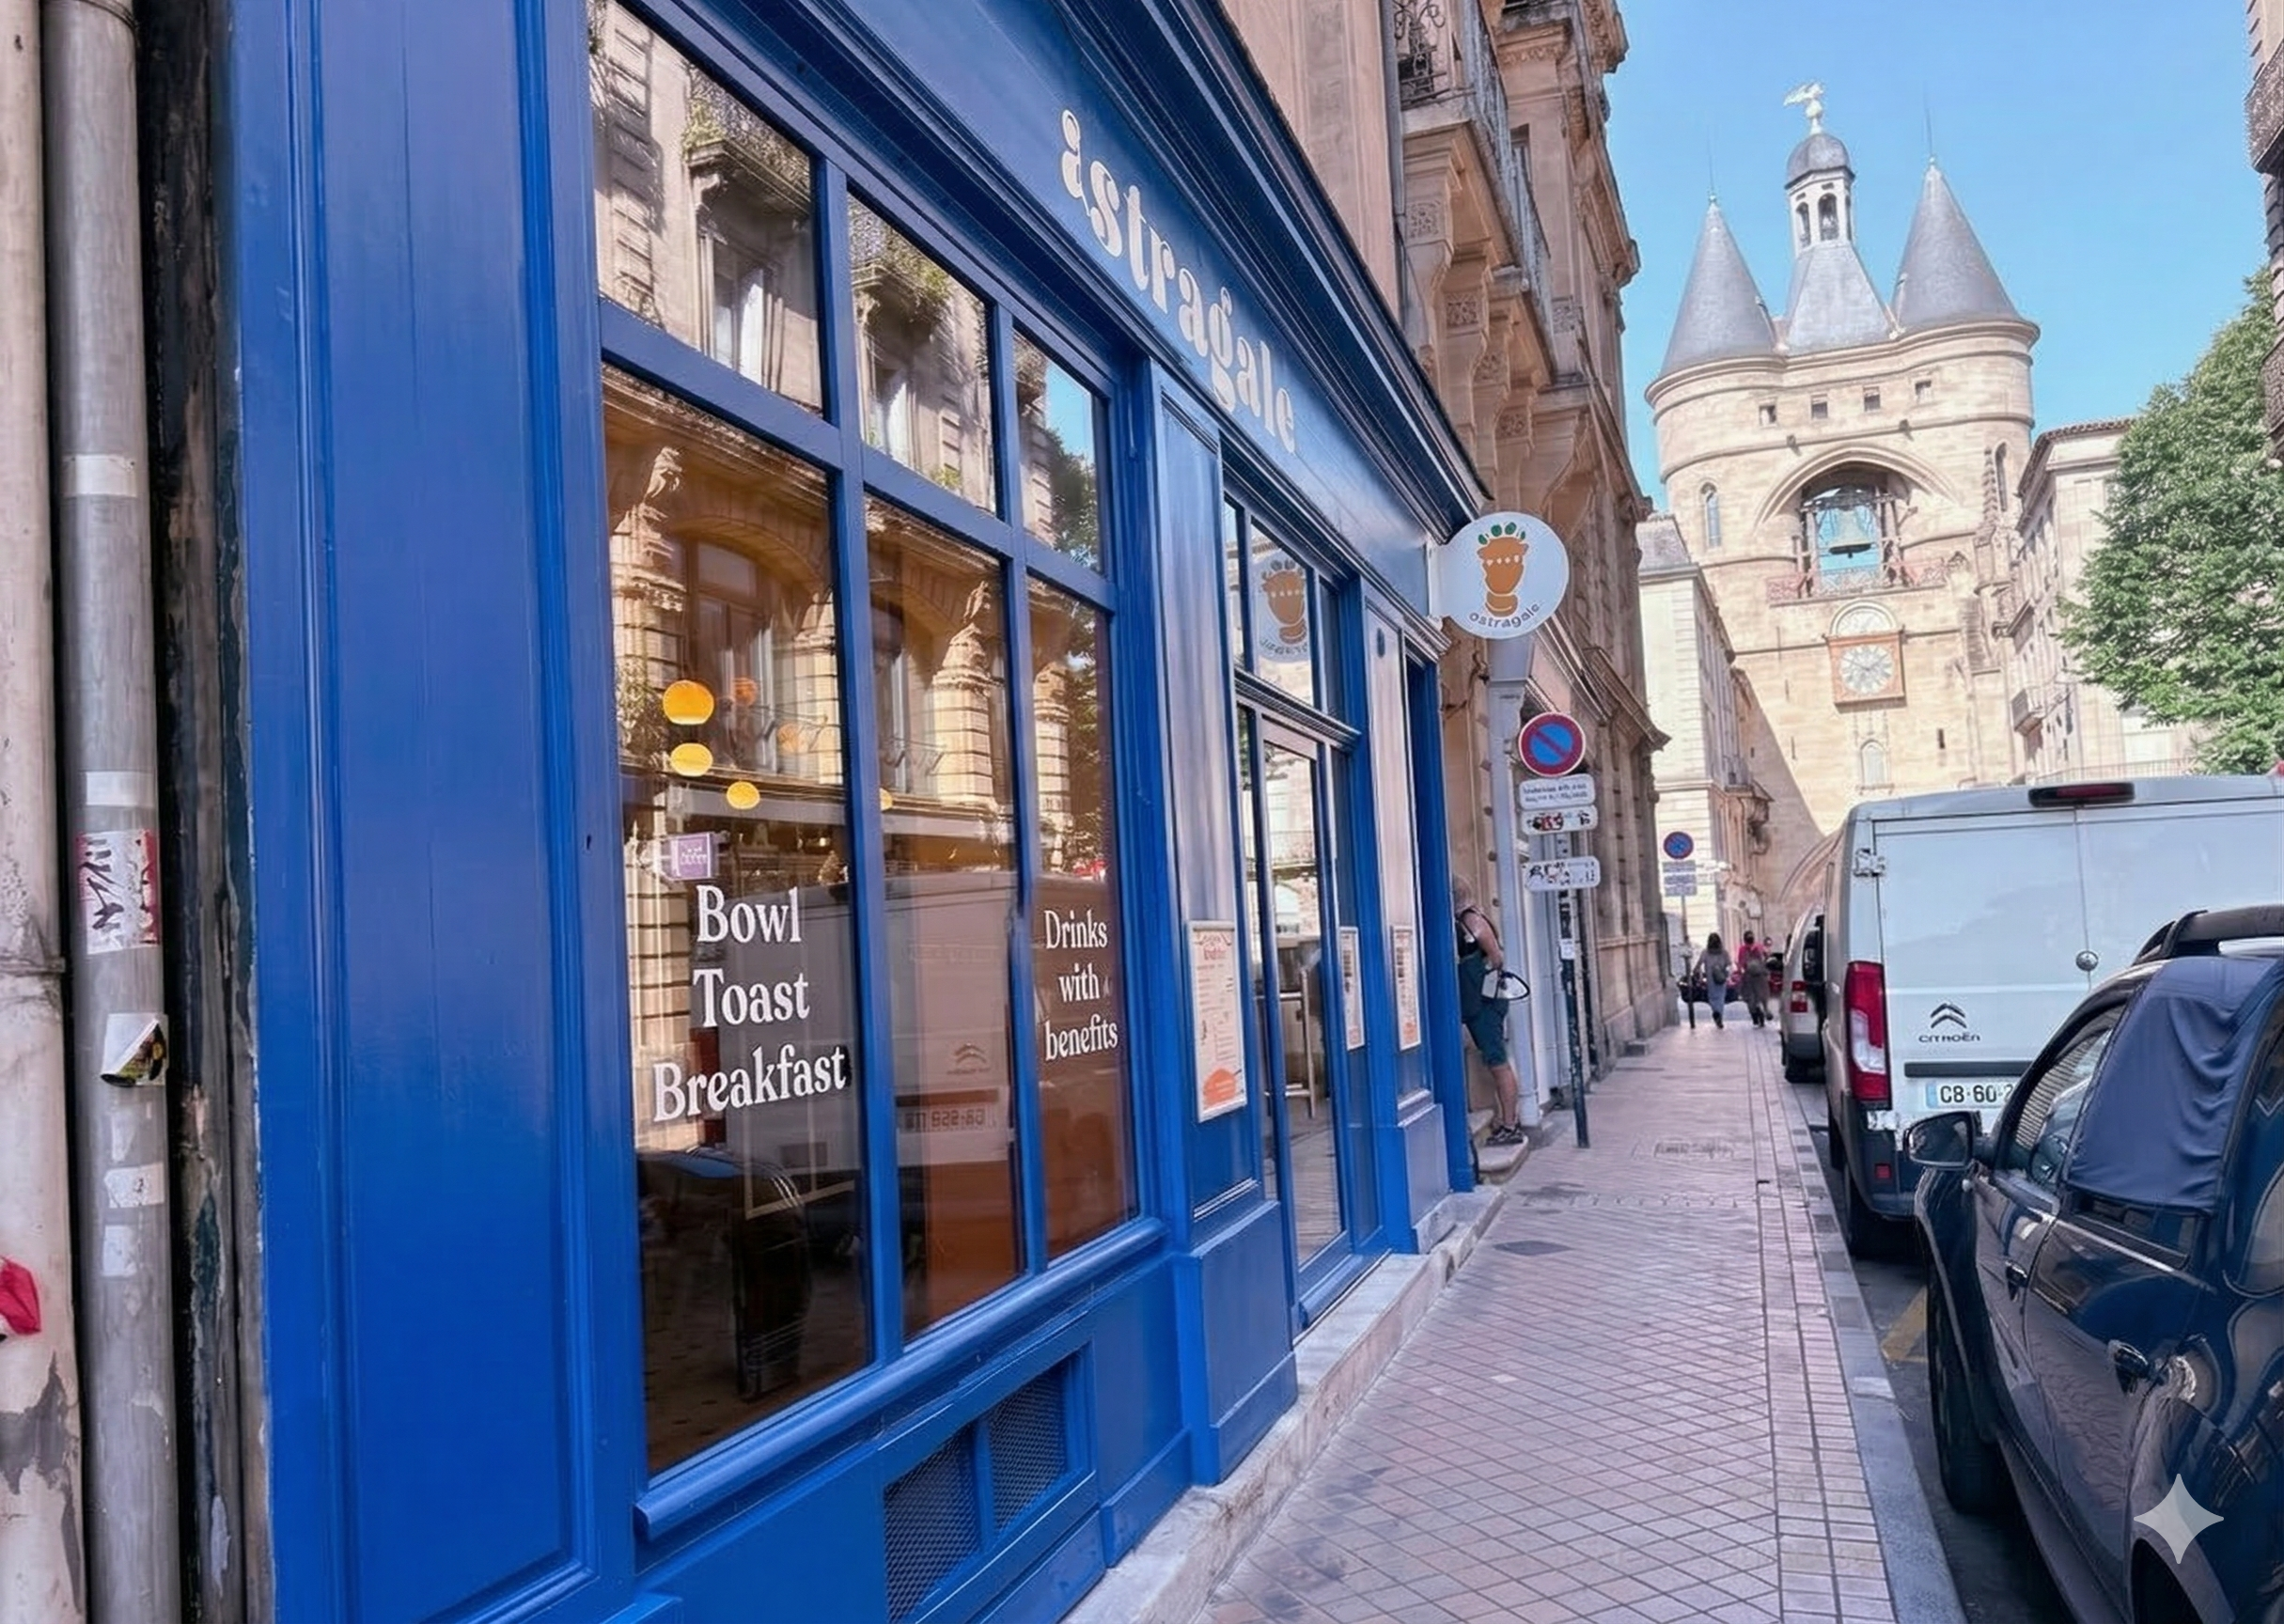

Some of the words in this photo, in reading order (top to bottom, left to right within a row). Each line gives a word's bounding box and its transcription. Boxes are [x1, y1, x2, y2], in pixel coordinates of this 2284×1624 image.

[696, 884, 802, 944] Bowl
[1044, 909, 1108, 950] Drinks
[693, 968, 810, 1029] Toast
[1058, 962, 1101, 1004] with
[1044, 1013, 1118, 1062] benefits
[653, 1044, 847, 1123] Breakfast
